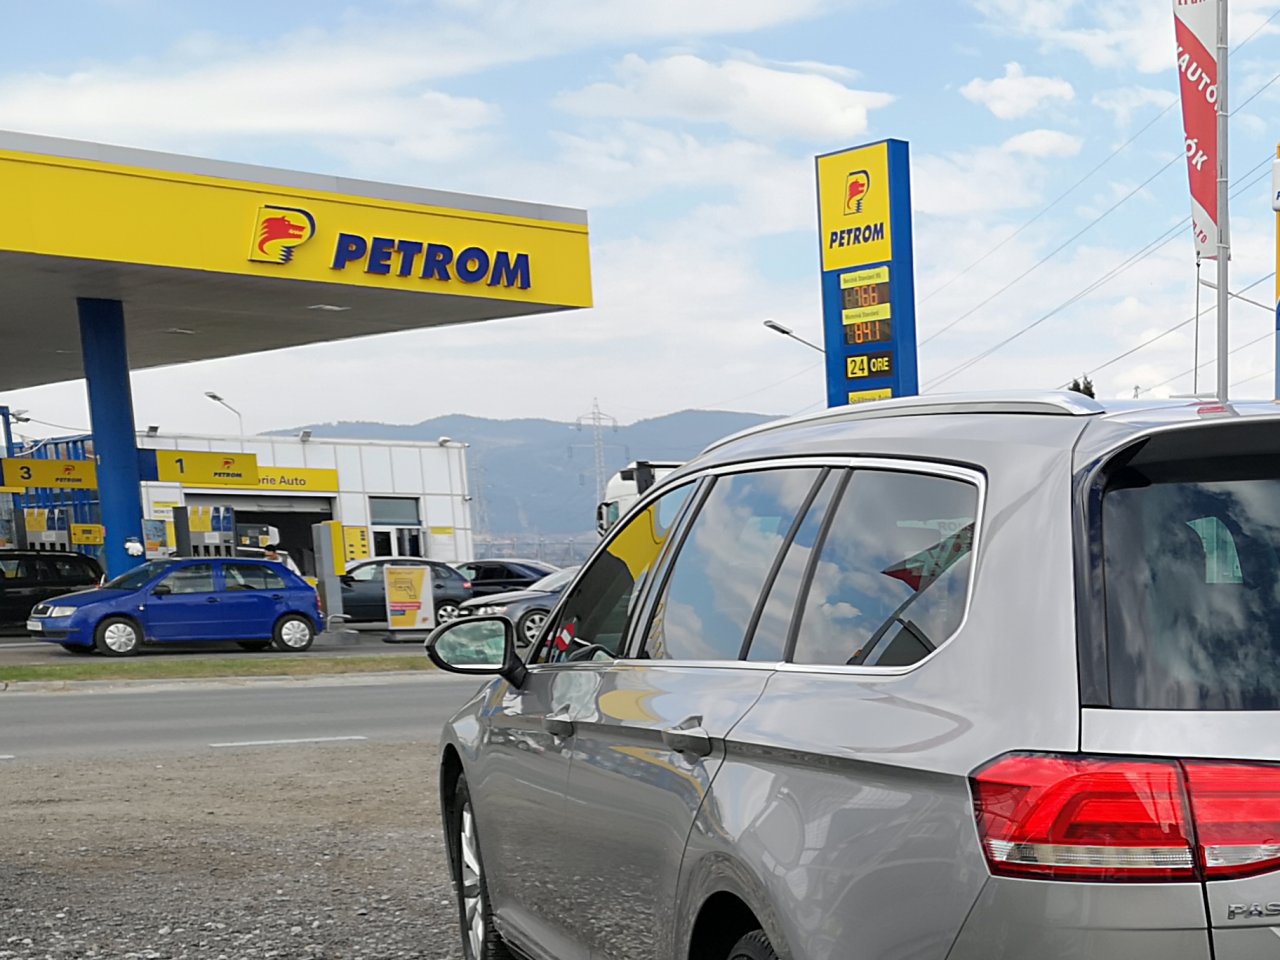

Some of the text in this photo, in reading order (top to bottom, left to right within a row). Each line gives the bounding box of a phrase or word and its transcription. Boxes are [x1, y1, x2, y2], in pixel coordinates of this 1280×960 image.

[829, 222, 884, 249] PETROM
[329, 232, 531, 290] PETROM
[849, 357, 889, 376] 24 ORE
[19, 466, 32, 480] 3
[174, 458, 185, 474] 1
[279, 475, 306, 486] Auto
